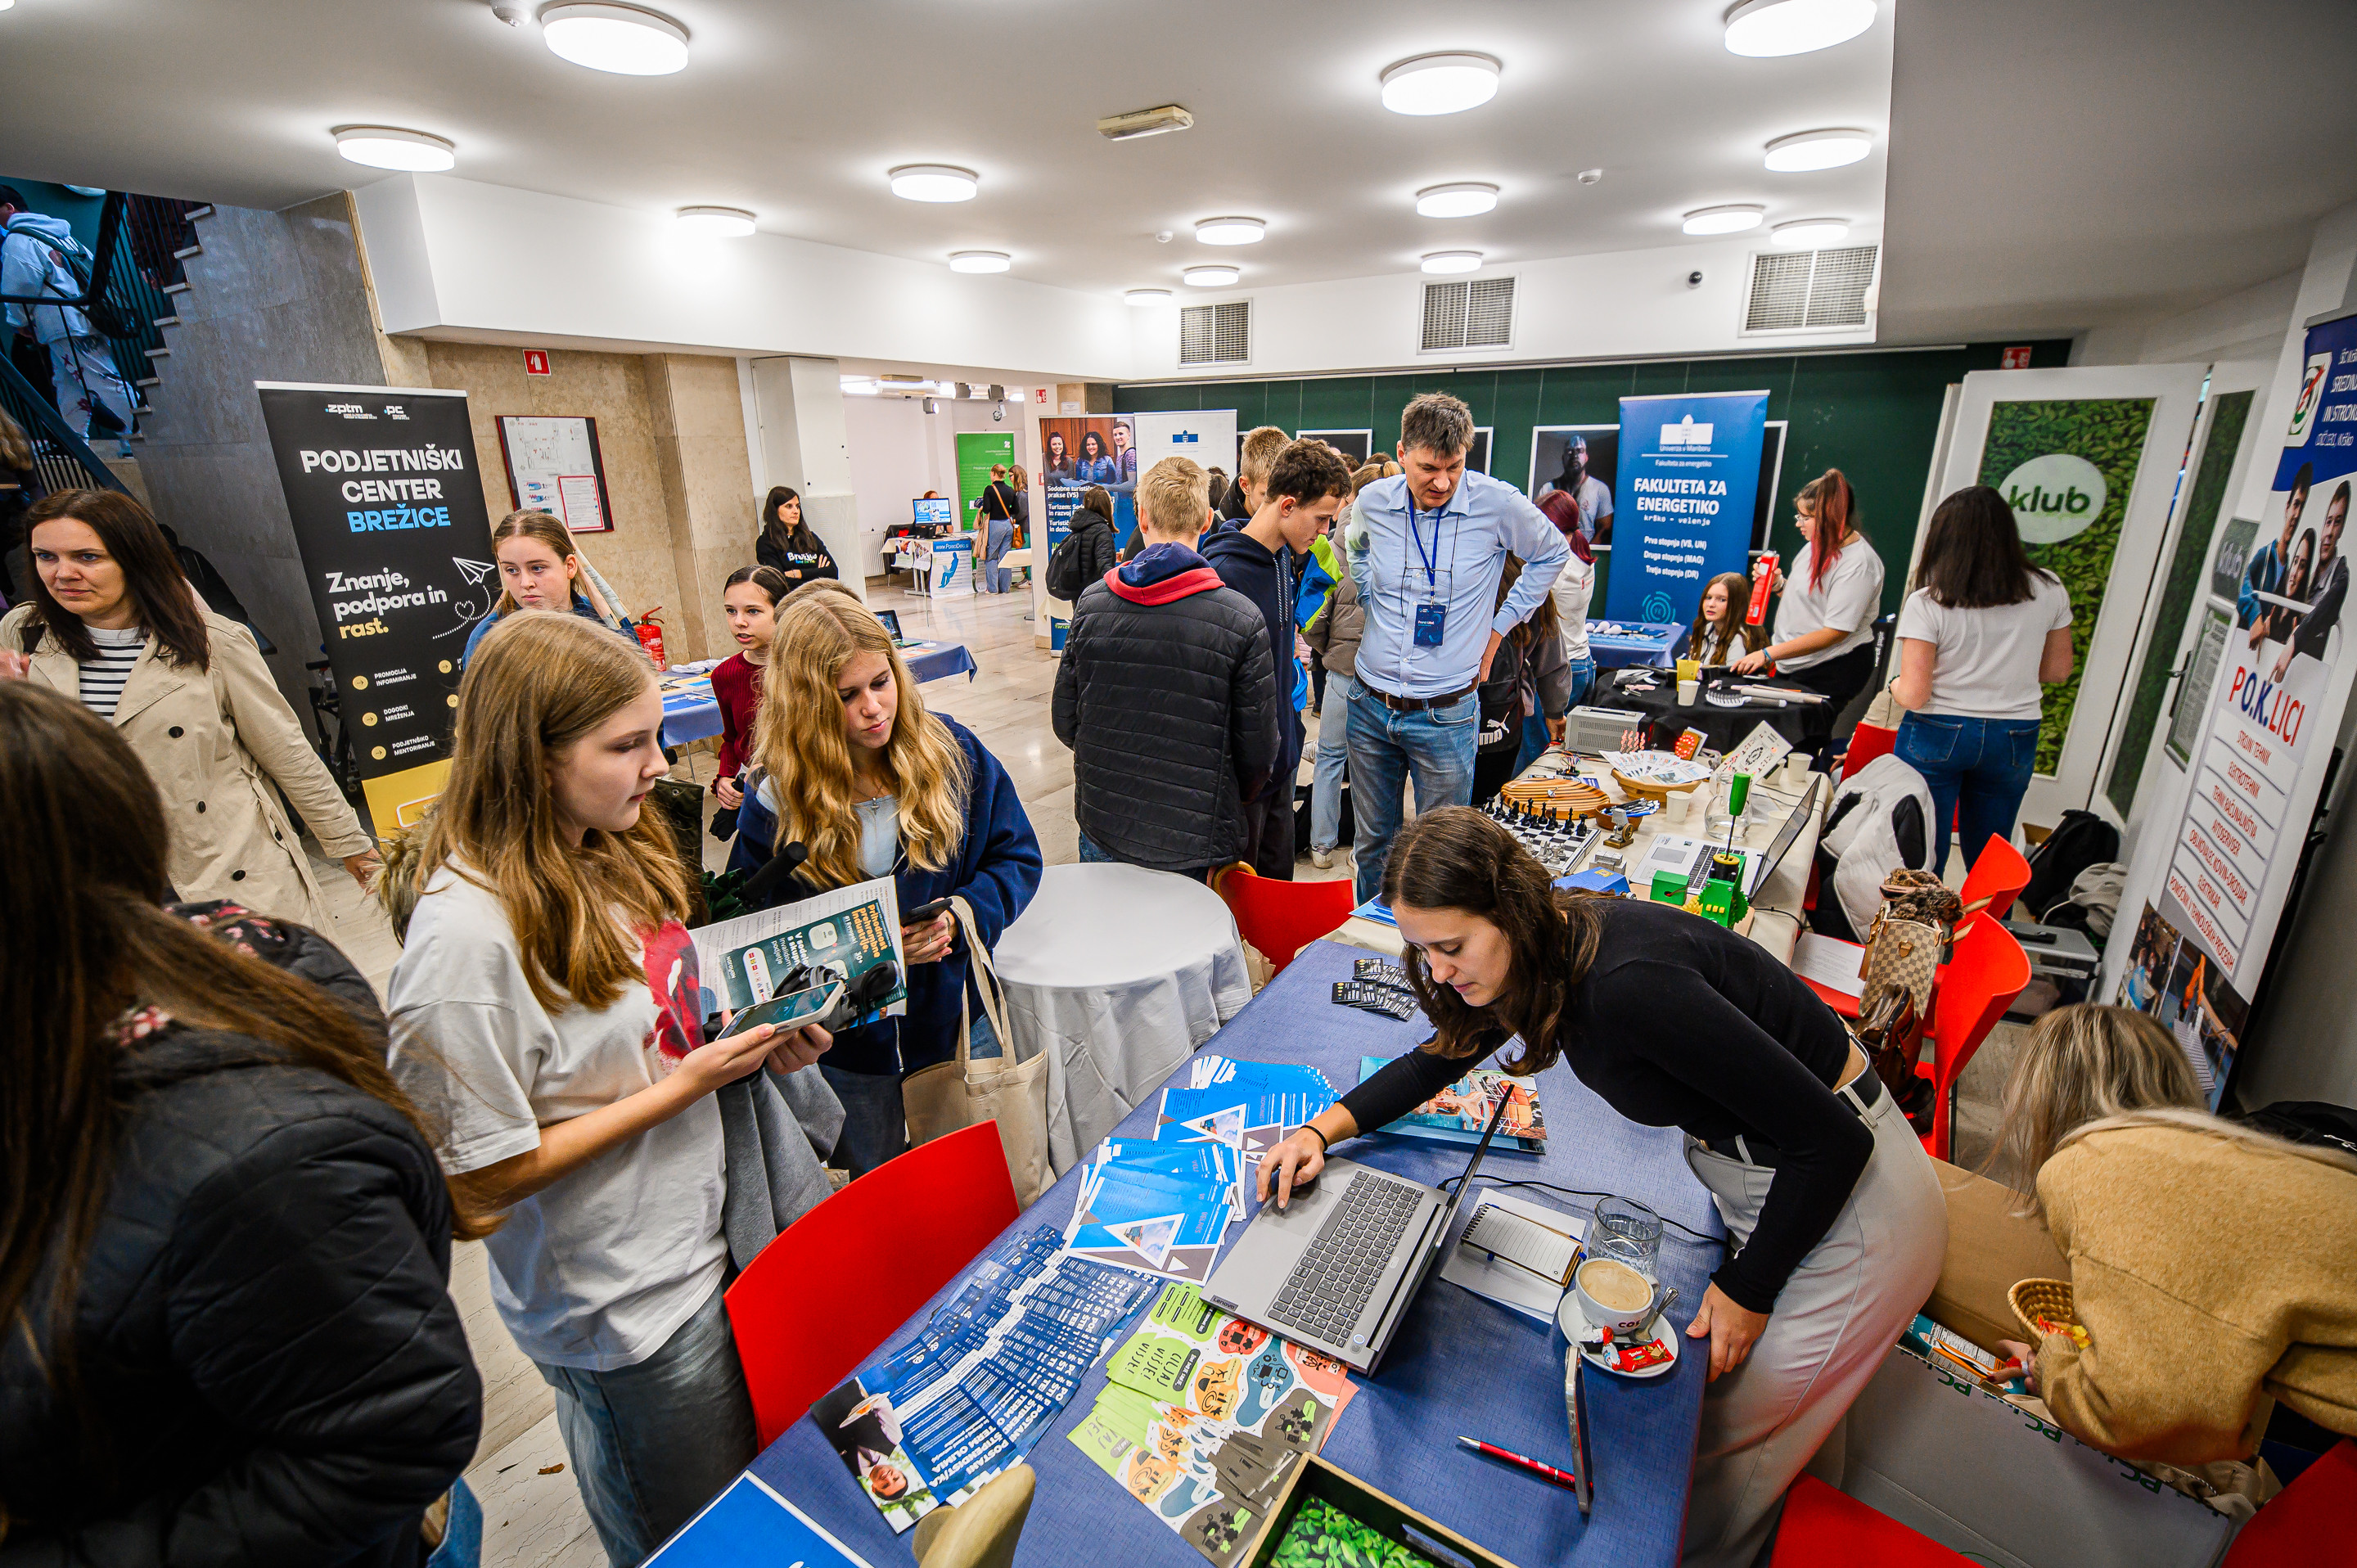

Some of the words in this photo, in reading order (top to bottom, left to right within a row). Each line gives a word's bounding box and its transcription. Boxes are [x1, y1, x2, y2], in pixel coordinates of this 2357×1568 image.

[300, 444, 464, 473] PODJETNIŠKI
[1686, 460, 1712, 469] energetiko
[341, 479, 444, 502] CENTER
[1634, 477, 1706, 494] FAKULTETA
[1708, 480, 1728, 496] ZA
[1637, 497, 1719, 516] ENERGETIKO
[2008, 485, 2090, 514] klub
[347, 503, 451, 533] BREŽICE
[1643, 514, 1666, 522] krško
[1678, 516, 1711, 527] velenje
[1643, 535, 1658, 545] Prva
[1658, 538, 1679, 548] stopnja
[1694, 540, 1707, 550] UN)
[1643, 550, 1661, 561] Druga
[1661, 553, 1683, 563] stopnja
[1684, 555, 1704, 565] (MAG)
[326, 567, 409, 593] Znanje,
[1646, 565, 1661, 575] Tretja
[1662, 568, 1683, 579] stopnja
[1684, 569, 1699, 580] (DR)
[333, 591, 426, 622] podpora
[426, 584, 448, 604] in
[339, 617, 389, 639] rast.
[374, 668, 408, 679] PROMOCIJA
[376, 674, 417, 687] INFORMIRANJE
[383, 704, 408, 714] DOGODKI
[385, 710, 415, 722] MREŽENJA
[394, 741, 435, 756] MENTORIRANJE
[1479, 728, 1503, 746] MA
[2253, 741, 2272, 766] TEHNIK
[2228, 760, 2261, 800] ELEKTROTEHNIK
[2211, 818, 2241, 857] AVTOSERVISER
[2197, 874, 2221, 910] ELEKTRIKAR
[859, 907, 881, 958] prehrambne
[868, 903, 888, 951] Prihodnost
[771, 940, 784, 965] podjetje
[789, 942, 800, 966] skupn
[854, 951, 863, 964] 30+
[1195, 1211, 1208, 1234] VELNES
[1213, 1297, 1235, 1310] Lenovo
[1156, 1353, 1182, 1387] CILJAJ
[1002, 1398, 1037, 1435] ŠTIPEND
[1003, 1395, 1028, 1419] TERM
[1008, 1404, 1044, 1443] POSTANI
[967, 1425, 997, 1449] TERM
[928, 1431, 1003, 1488] ŠTIPENDIST/KA
[931, 1445, 969, 1474] OLIMIA
[966, 1439, 1010, 1476] POSTANI
